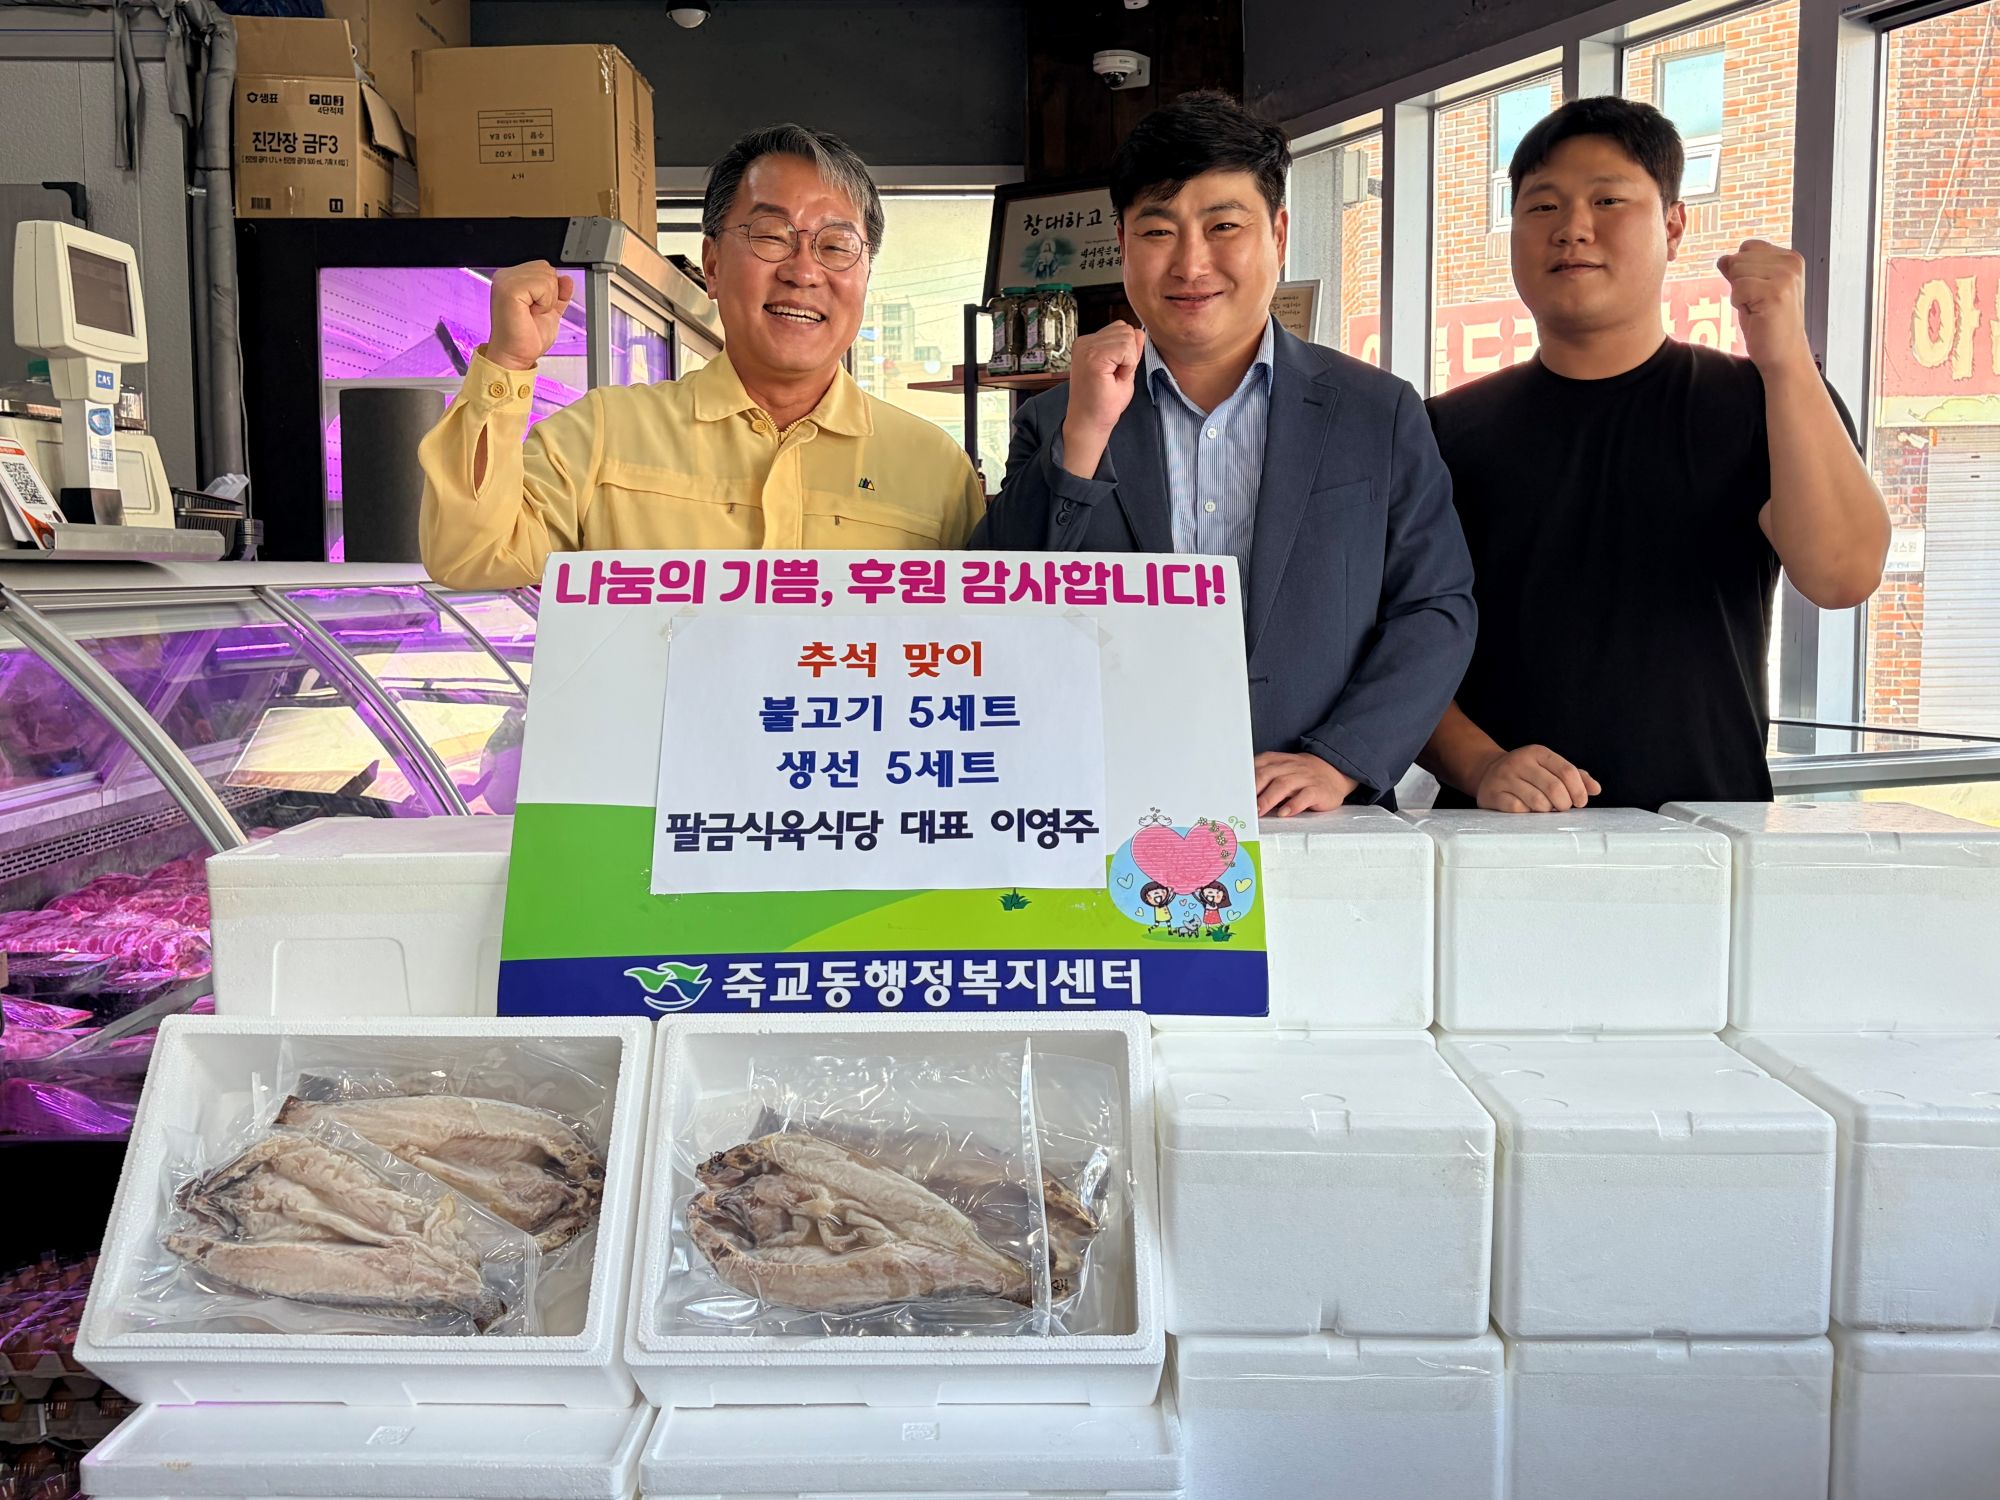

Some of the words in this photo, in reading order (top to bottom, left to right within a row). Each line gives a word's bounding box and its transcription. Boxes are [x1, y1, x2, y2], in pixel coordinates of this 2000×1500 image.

[317, 106, 344, 116] 4단적재
[251, 131, 298, 155] 진간장
[302, 133, 339, 155] 금F3
[1023, 208, 1103, 237] 창대하고
[1909, 275, 2000, 382] 아
[97, 374, 111, 386] CAS
[555, 559, 706, 605] 나눔의
[719, 559, 833, 607] 기쁨,
[847, 558, 946, 604] 후원
[961, 560, 1226, 607] 감사합니다!
[797, 641, 877, 678] 추석
[902, 640, 982, 678] 맞이
[758, 694, 883, 733] 불고기
[908, 694, 1021, 732] 5세트
[775, 750, 859, 790] 생선
[885, 749, 1000, 788] 5세트
[665, 809, 884, 853] 팔금식육식당
[900, 808, 974, 846] 대표
[990, 807, 1100, 852] 이영주
[722, 959, 1143, 1008] 죽교동행정복지센터
